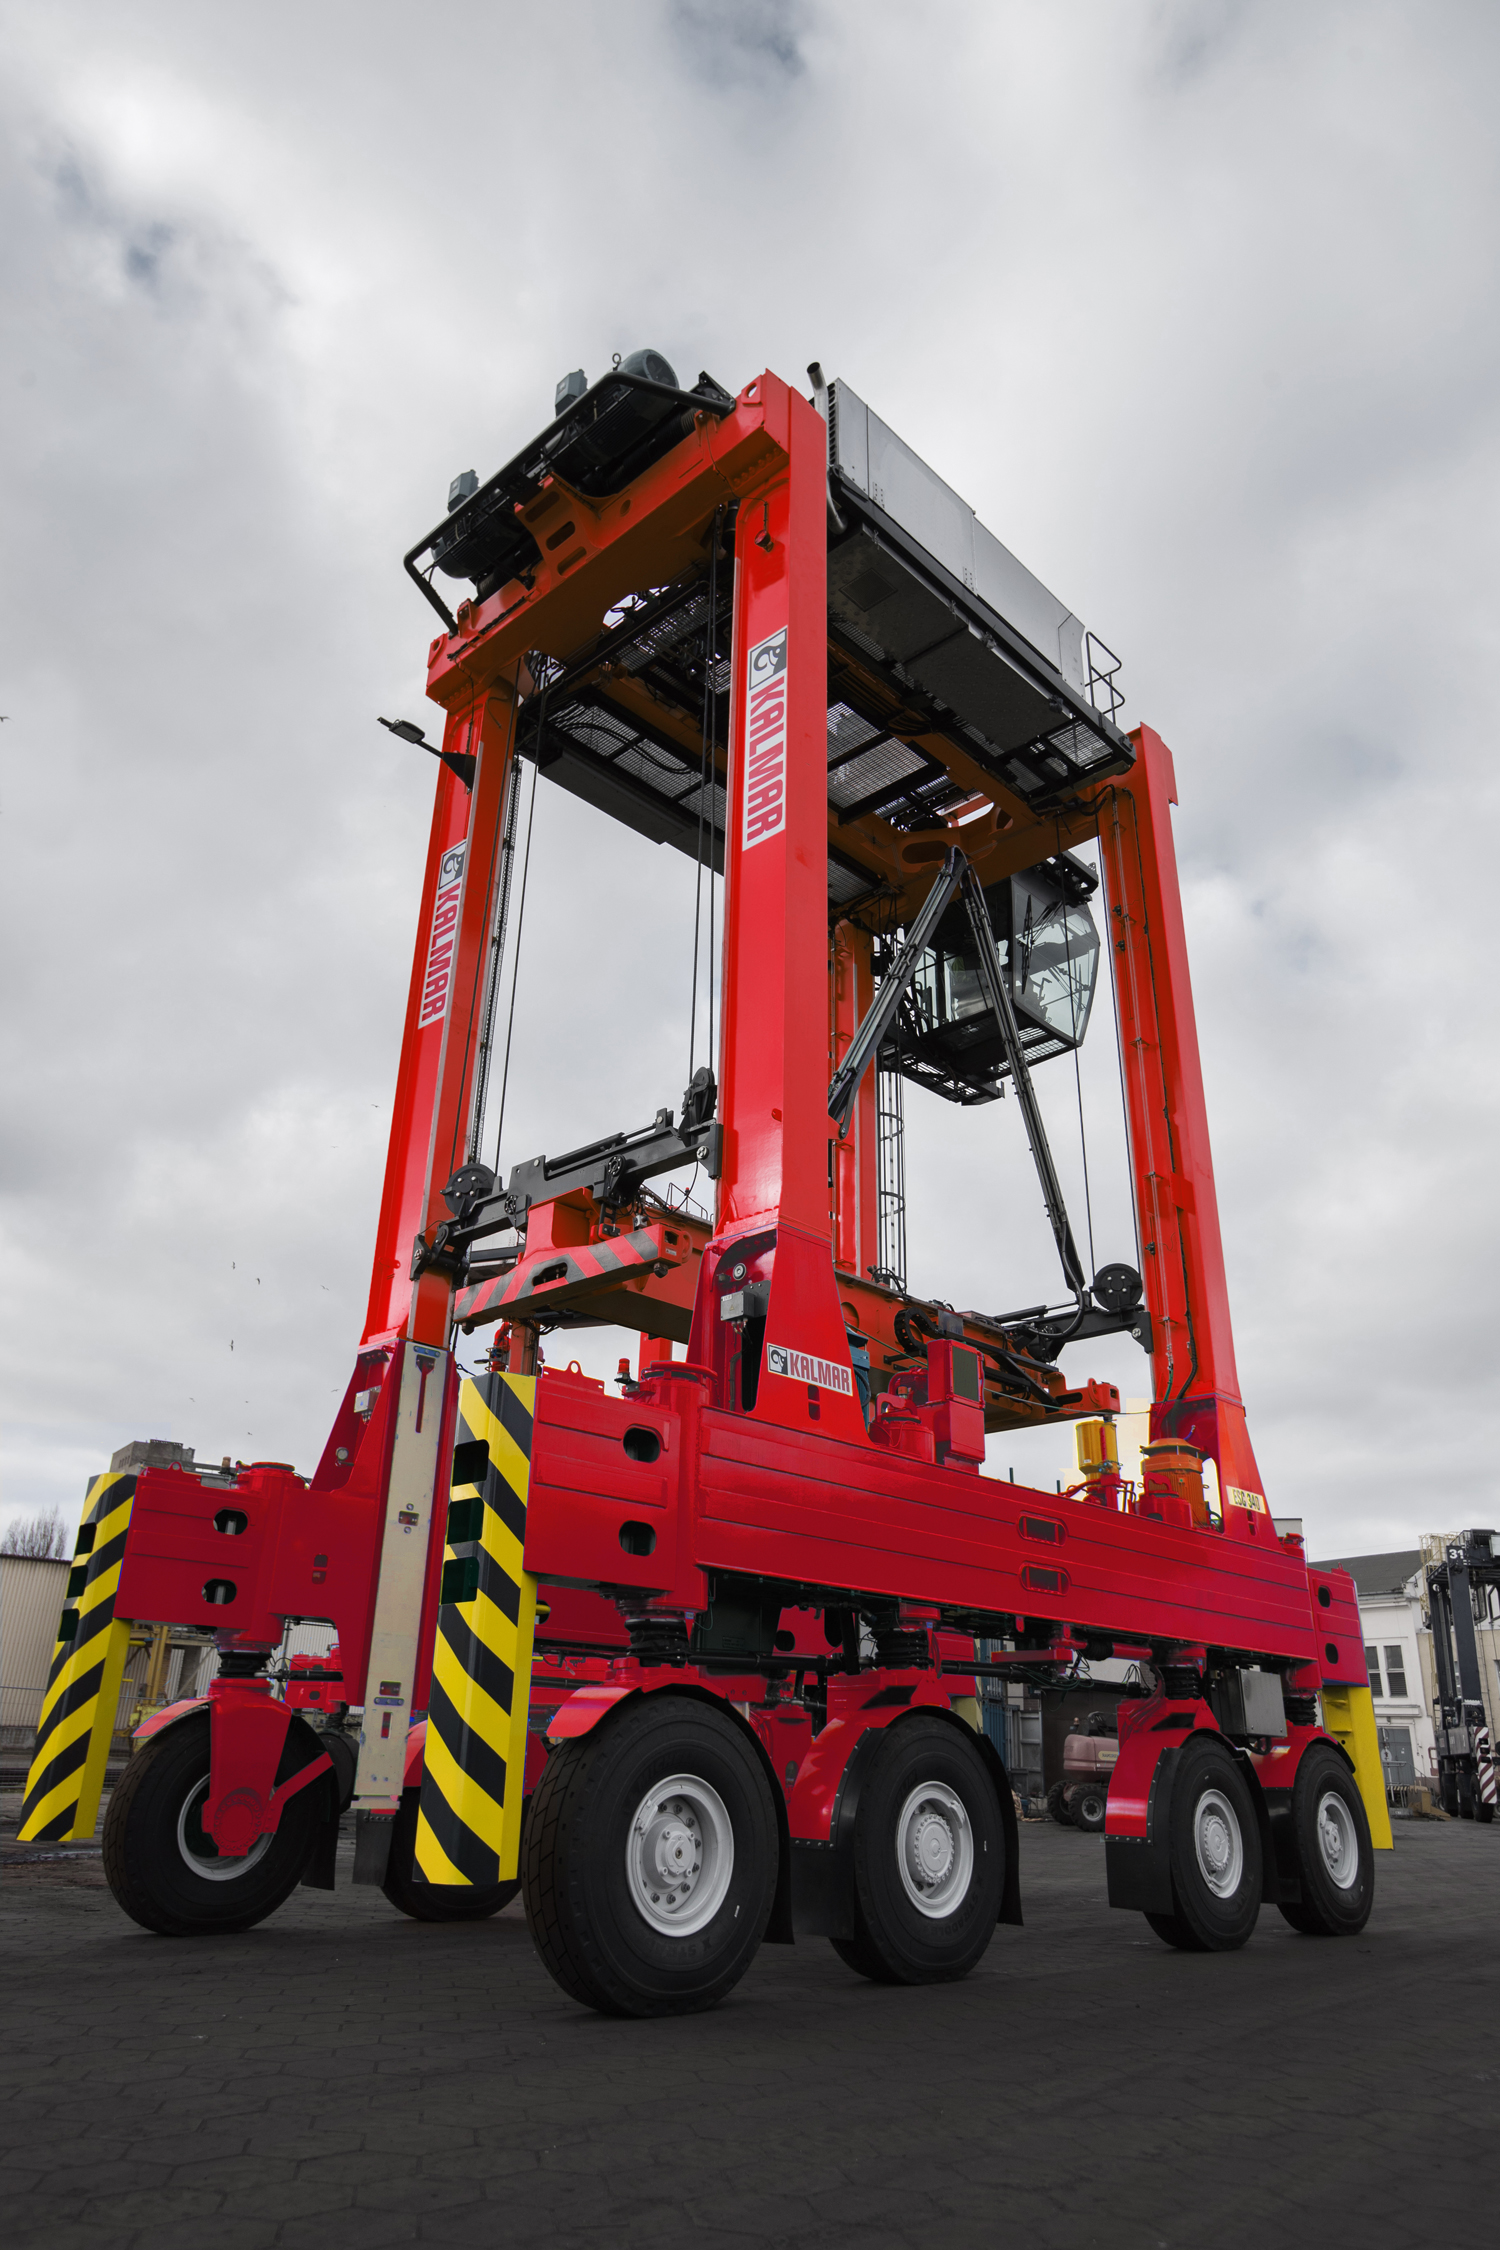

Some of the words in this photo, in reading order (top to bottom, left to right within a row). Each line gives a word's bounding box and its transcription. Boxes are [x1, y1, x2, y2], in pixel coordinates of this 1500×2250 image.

[746, 675, 785, 842] KALMAR
[421, 882, 461, 1022] KALMAR
[789, 1352, 850, 1393] KALMAR
[1246, 1492, 1261, 1511] 340
[1448, 1548, 1464, 1559] 31
